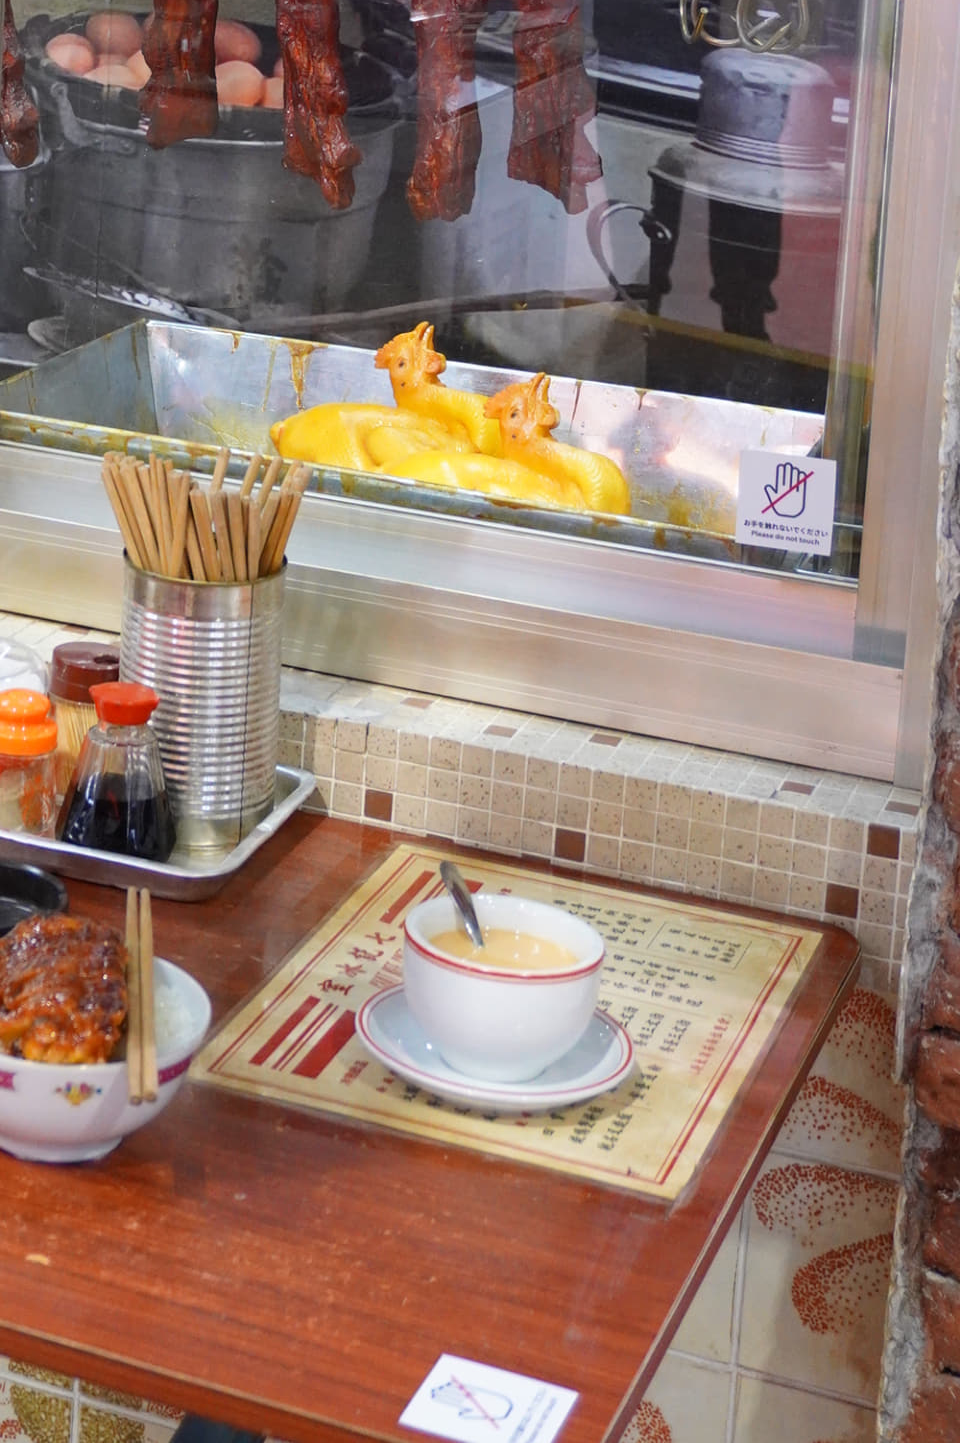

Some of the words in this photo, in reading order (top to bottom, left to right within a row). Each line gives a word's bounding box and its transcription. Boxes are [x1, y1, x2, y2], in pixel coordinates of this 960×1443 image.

[751, 529, 774, 540] Please
[775, 532, 785, 541] do
[785, 533, 798, 543] not
[799, 535, 820, 546] touch
